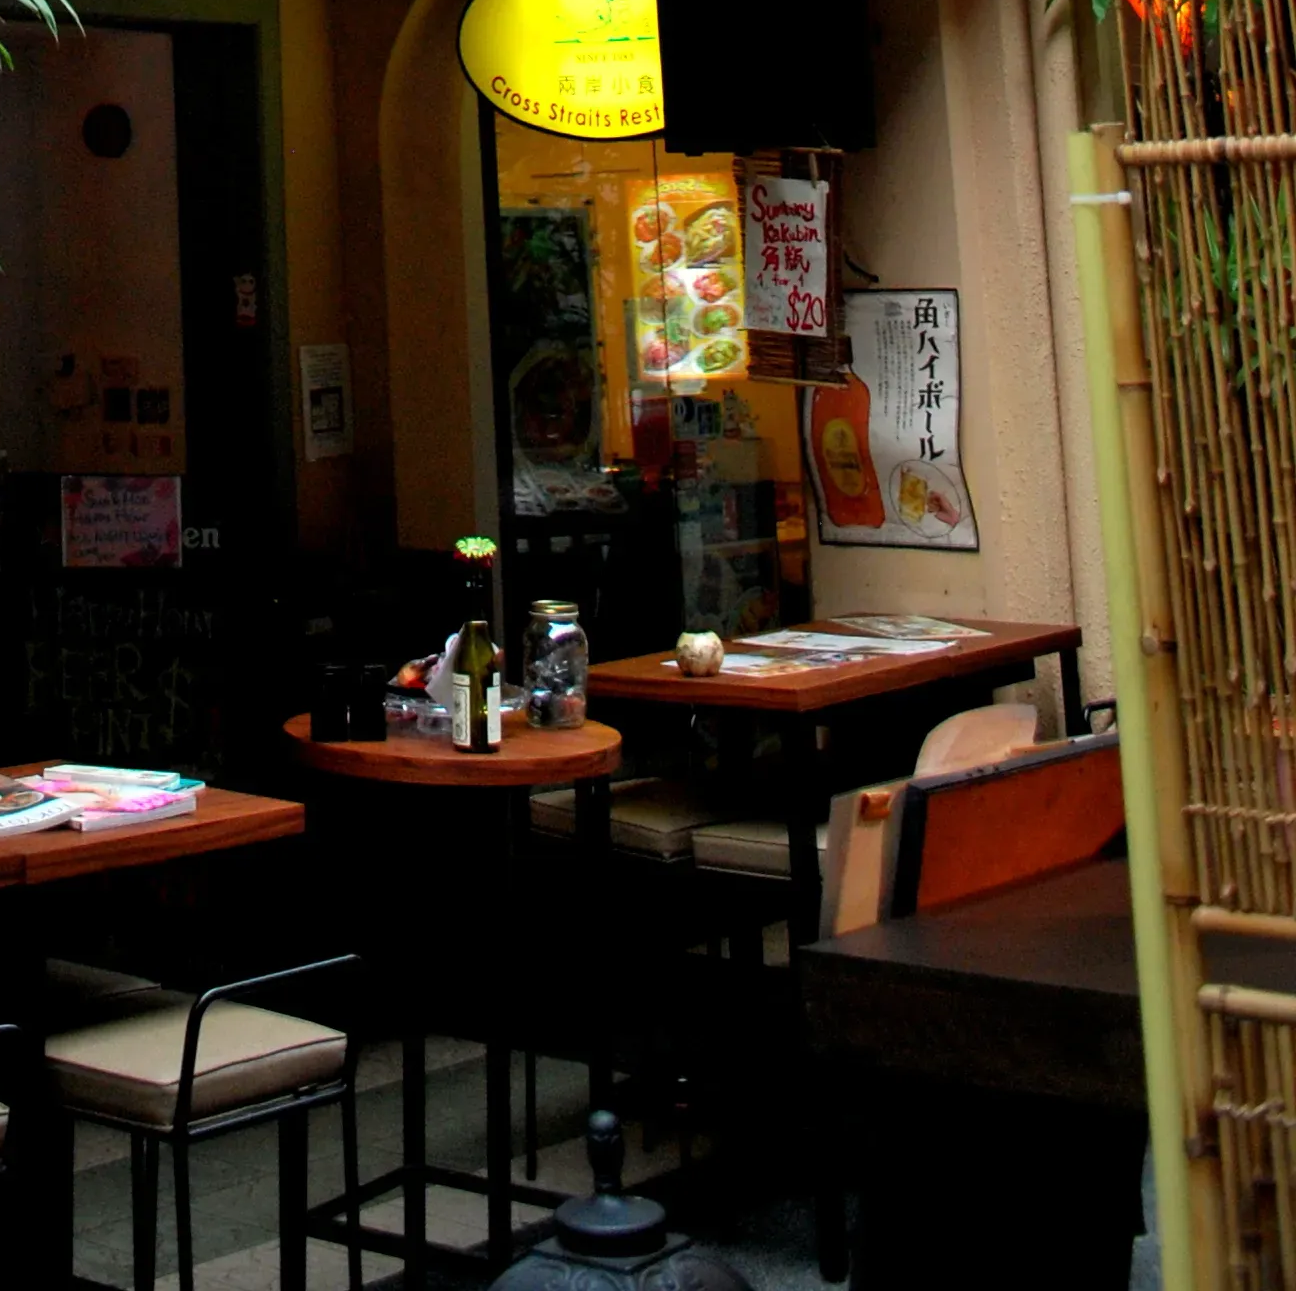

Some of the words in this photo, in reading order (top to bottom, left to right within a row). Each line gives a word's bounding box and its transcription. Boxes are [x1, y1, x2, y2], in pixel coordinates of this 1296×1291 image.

[491, 76, 540, 115] Cross
[548, 102, 611, 127] Straits
[786, 284, 824, 332] $20
[913, 297, 945, 462] 角ハイボール
